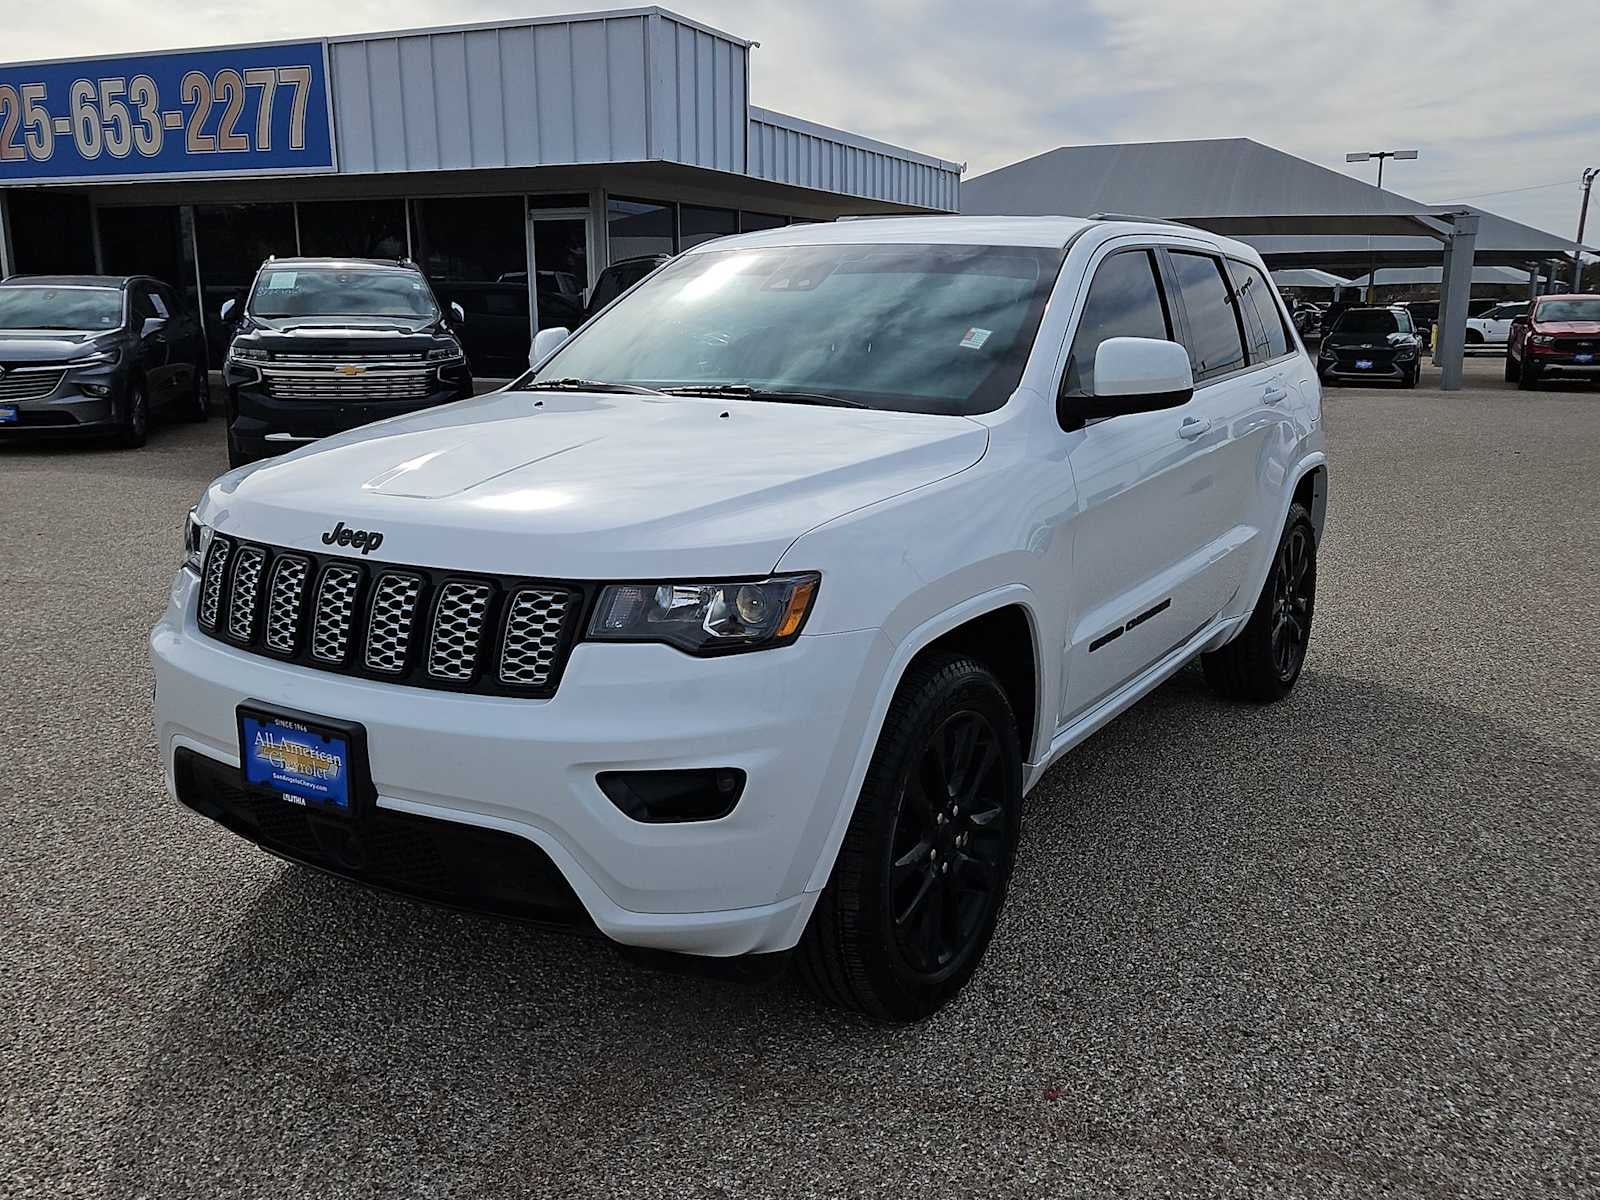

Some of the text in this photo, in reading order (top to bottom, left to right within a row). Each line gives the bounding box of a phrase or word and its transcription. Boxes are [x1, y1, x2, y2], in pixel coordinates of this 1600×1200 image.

[322, 521, 384, 555] Jeep
[274, 718, 294, 729] SINCE
[254, 731, 342, 767] All American
